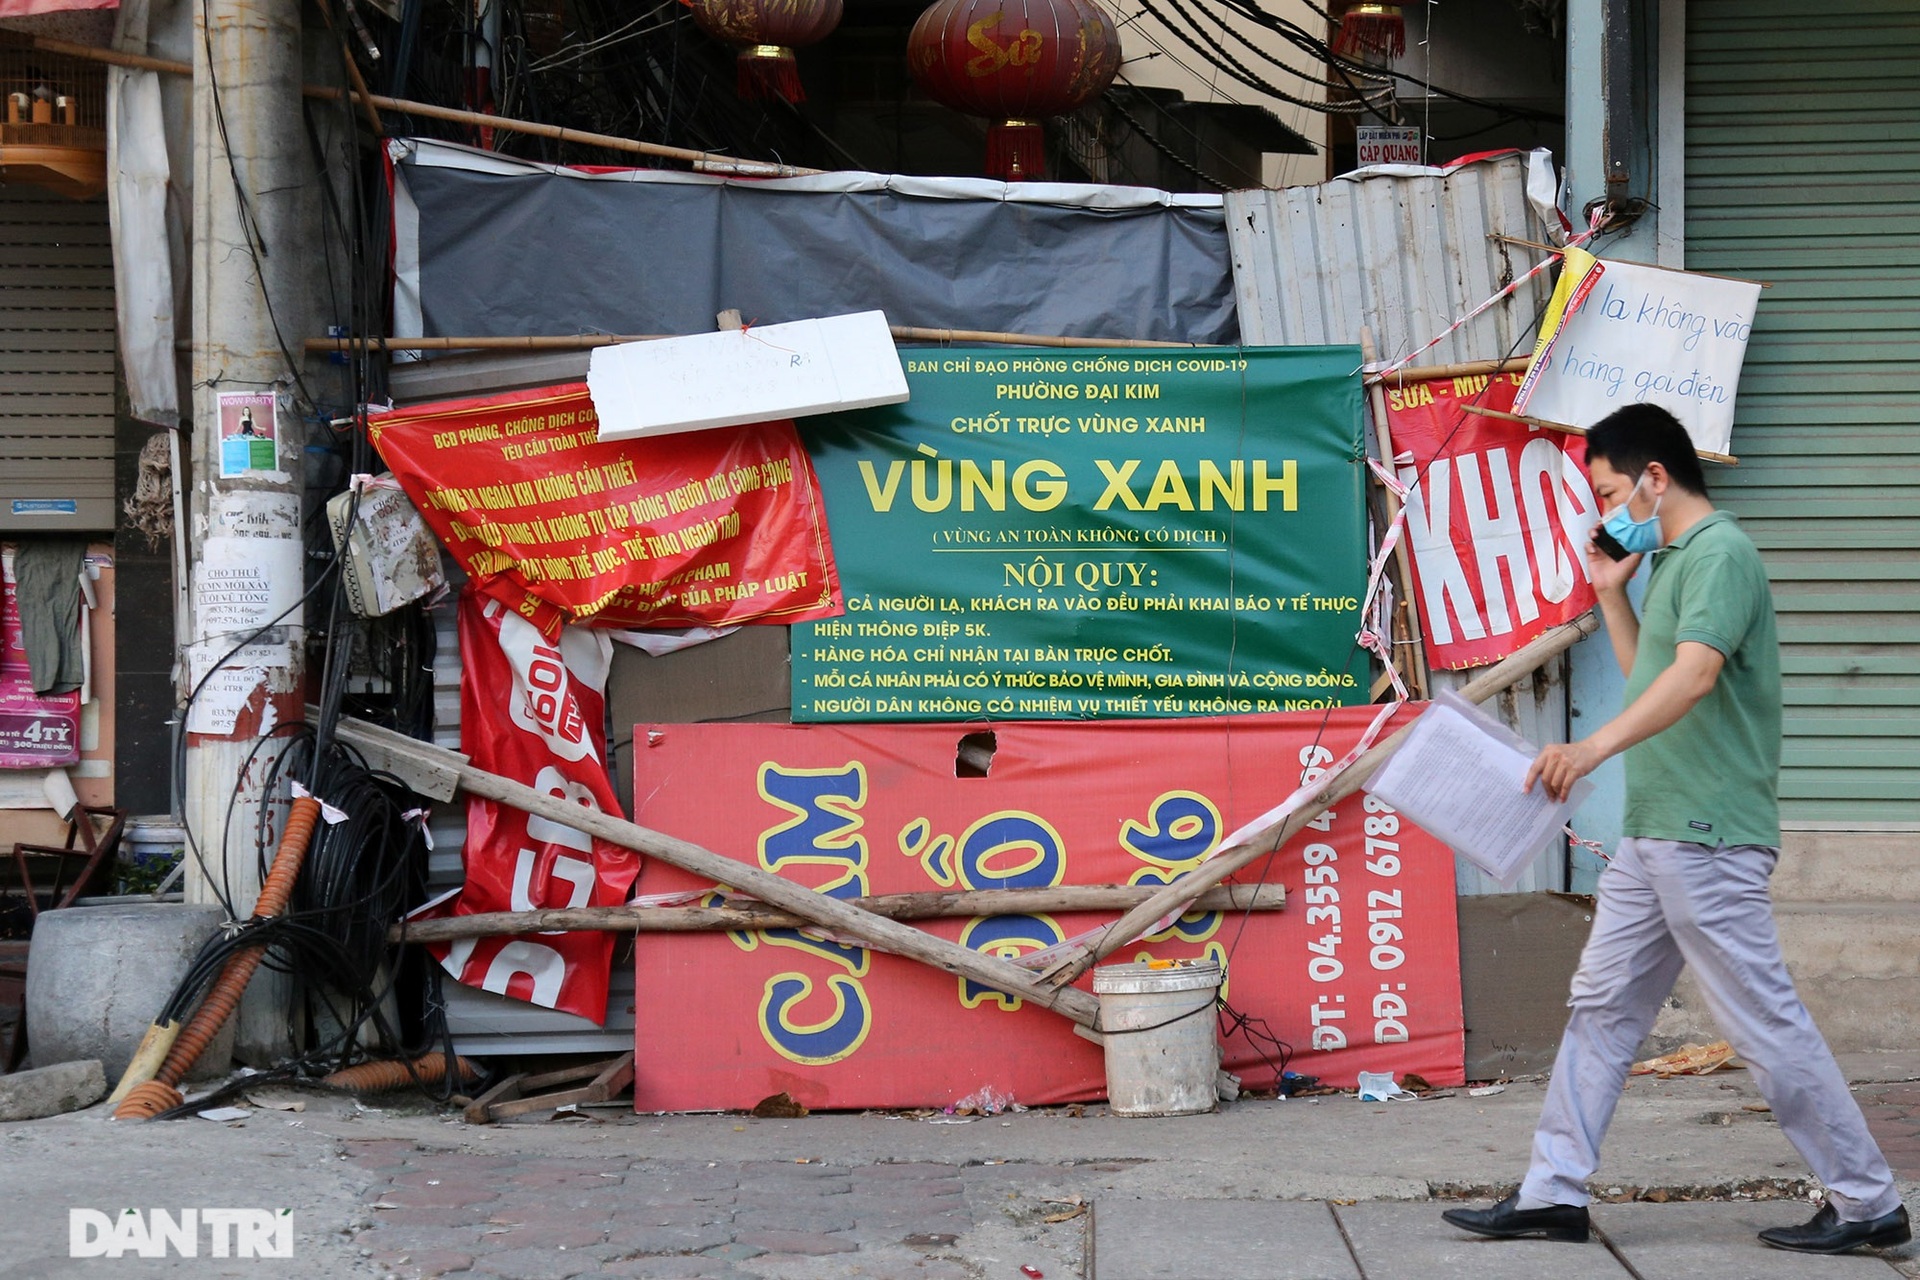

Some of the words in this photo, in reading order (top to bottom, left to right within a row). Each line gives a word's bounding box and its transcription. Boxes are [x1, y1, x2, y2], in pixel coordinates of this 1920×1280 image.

[1383, 144, 1419, 164] QUANG
[1600, 284, 1630, 322] lạ
[1637, 293, 1706, 351] không
[1714, 313, 1750, 341] vào
[908, 360, 941, 373] BAN
[943, 357, 972, 373] CHỈ
[974, 360, 1010, 376] ĐẠO
[1013, 357, 1067, 373] PHÒNG
[1071, 355, 1131, 373] CHỐNG
[1134, 359, 1174, 376] DỊCH
[1176, 360, 1248, 374] COVID-19
[1562, 345, 1625, 398] hàng
[1634, 370, 1675, 403] gọi
[1677, 368, 1729, 405] điện
[220, 396, 244, 406] WOW
[245, 395, 274, 405] PARTY
[996, 378, 1080, 399] PHƯỜNG
[1084, 383, 1120, 403] ĐẠI
[1124, 384, 1160, 399] KIM
[459, 423, 504, 445] PHÒNG,
[504, 415, 545, 437] CHỐNG
[548, 413, 576, 432] DỊCH
[951, 411, 1009, 434] CHỐT
[1018, 415, 1071, 438] TRỰC
[1077, 411, 1139, 434] VÙNG
[1145, 417, 1205, 433] XANH
[501, 443, 524, 461] YÊU
[525, 435, 547, 455] CẦU
[548, 432, 578, 452] TOÀN
[477, 480, 513, 510] NGOÀI
[513, 481, 534, 507] KHI
[534, 472, 578, 503] KHÔNG
[576, 461, 604, 495] CẦN
[602, 452, 638, 488] THIẾT
[857, 443, 1068, 512] VÙNG
[1092, 460, 1298, 511] XANH
[530, 516, 552, 544] VÀ
[547, 511, 591, 542] KHÔNG
[588, 510, 608, 538] TỤ
[606, 501, 630, 531] TẬP
[631, 494, 669, 525] ĐÔNG
[665, 477, 708, 514] NGƯỜI
[705, 472, 732, 500] NƠI
[730, 464, 761, 494] CÔNG
[760, 456, 793, 492] CỘNG
[569, 544, 596, 579] THỂ
[594, 547, 628, 574] DỤC,
[621, 531, 648, 562] THỂ
[645, 531, 682, 559] THAO
[679, 516, 720, 551] NGOÀI
[717, 506, 741, 540] TRỜI
[942, 526, 991, 543] VÙNG
[995, 529, 1020, 543] AN
[1024, 526, 1072, 543] TOÀN
[1077, 526, 1140, 543] KHÔNG
[1144, 525, 1170, 543] CÓ
[1174, 529, 1217, 547] DỊCH
[207, 569, 229, 578] CHO
[231, 566, 261, 578] THUÊ
[684, 562, 731, 583] PHẠM
[1003, 556, 1065, 593] NỘI
[1074, 561, 1158, 592] QUY:
[681, 585, 712, 607] CỦA
[714, 579, 760, 603] PHÁP
[765, 572, 808, 594] LUẬT
[847, 594, 873, 611] CẢ
[879, 595, 935, 611] NGƯỜI
[940, 598, 965, 614] LẠ,
[970, 595, 1031, 611] KHÁCH
[1036, 598, 1058, 611] RA
[1063, 595, 1101, 611] VÀO
[1106, 591, 1138, 611] ĐỀU
[1144, 593, 1184, 611] PHẢI
[1189, 598, 1229, 611] KHAI
[1235, 594, 1270, 611] BÁO
[1276, 598, 1286, 611] Y
[1291, 593, 1309, 611] TẾ
[1313, 596, 1358, 614] THỰC
[814, 620, 852, 640] HIỆN
[858, 620, 918, 637] THÔNG
[923, 620, 960, 640] ĐIỆP
[964, 624, 991, 637] 5K.
[814, 646, 865, 662] HÀNG
[870, 645, 908, 662] HÓA
[913, 644, 944, 662] CHỈ
[950, 646, 998, 665] NHẬN
[1003, 649, 1029, 665] TẠI
[1035, 645, 1069, 662] BÀN
[1074, 648, 1118, 665] TRỰC
[1123, 643, 1174, 662] CHỐT.
[814, 668, 845, 688] MỖI
[848, 671, 873, 687] CÁ
[876, 671, 920, 687] NHÂN
[924, 670, 959, 687] PHẢI
[963, 671, 989, 687] CÓ
[991, 670, 1002, 687] Ý
[1005, 671, 1046, 687] THỨC
[1049, 669, 1083, 687] BẢO
[1086, 671, 1104, 690] VỆ
[1108, 671, 1152, 690] MÌNH,
[1154, 674, 1180, 687] GIA
[1186, 671, 1224, 687] ĐÌNH
[1227, 671, 1250, 687] VÀ
[1253, 671, 1303, 690] CỘNG
[1305, 667, 1358, 688] ĐỒNG.
[814, 696, 870, 713] NGƯỜI
[876, 696, 912, 712] DÂN
[918, 696, 982, 713] KHÔNG
[987, 696, 1014, 713] CÓ
[1019, 696, 1072, 716] NHIỆM
[1081, 699, 1100, 716] VỤ
[1105, 694, 1147, 712] THIẾT
[1153, 694, 1183, 712] YẾU
[1189, 696, 1252, 712] KHÔNG
[1258, 699, 1279, 712] RA
[23, 720, 42, 742] 4
[42, 722, 71, 741] TỶ
[1299, 744, 1338, 831] 499
[1303, 843, 1345, 982] 04.3559
[1367, 889, 1405, 970] 0912
[1311, 994, 1347, 1051] ĐT:
[1373, 983, 1409, 1044] DĐ:
